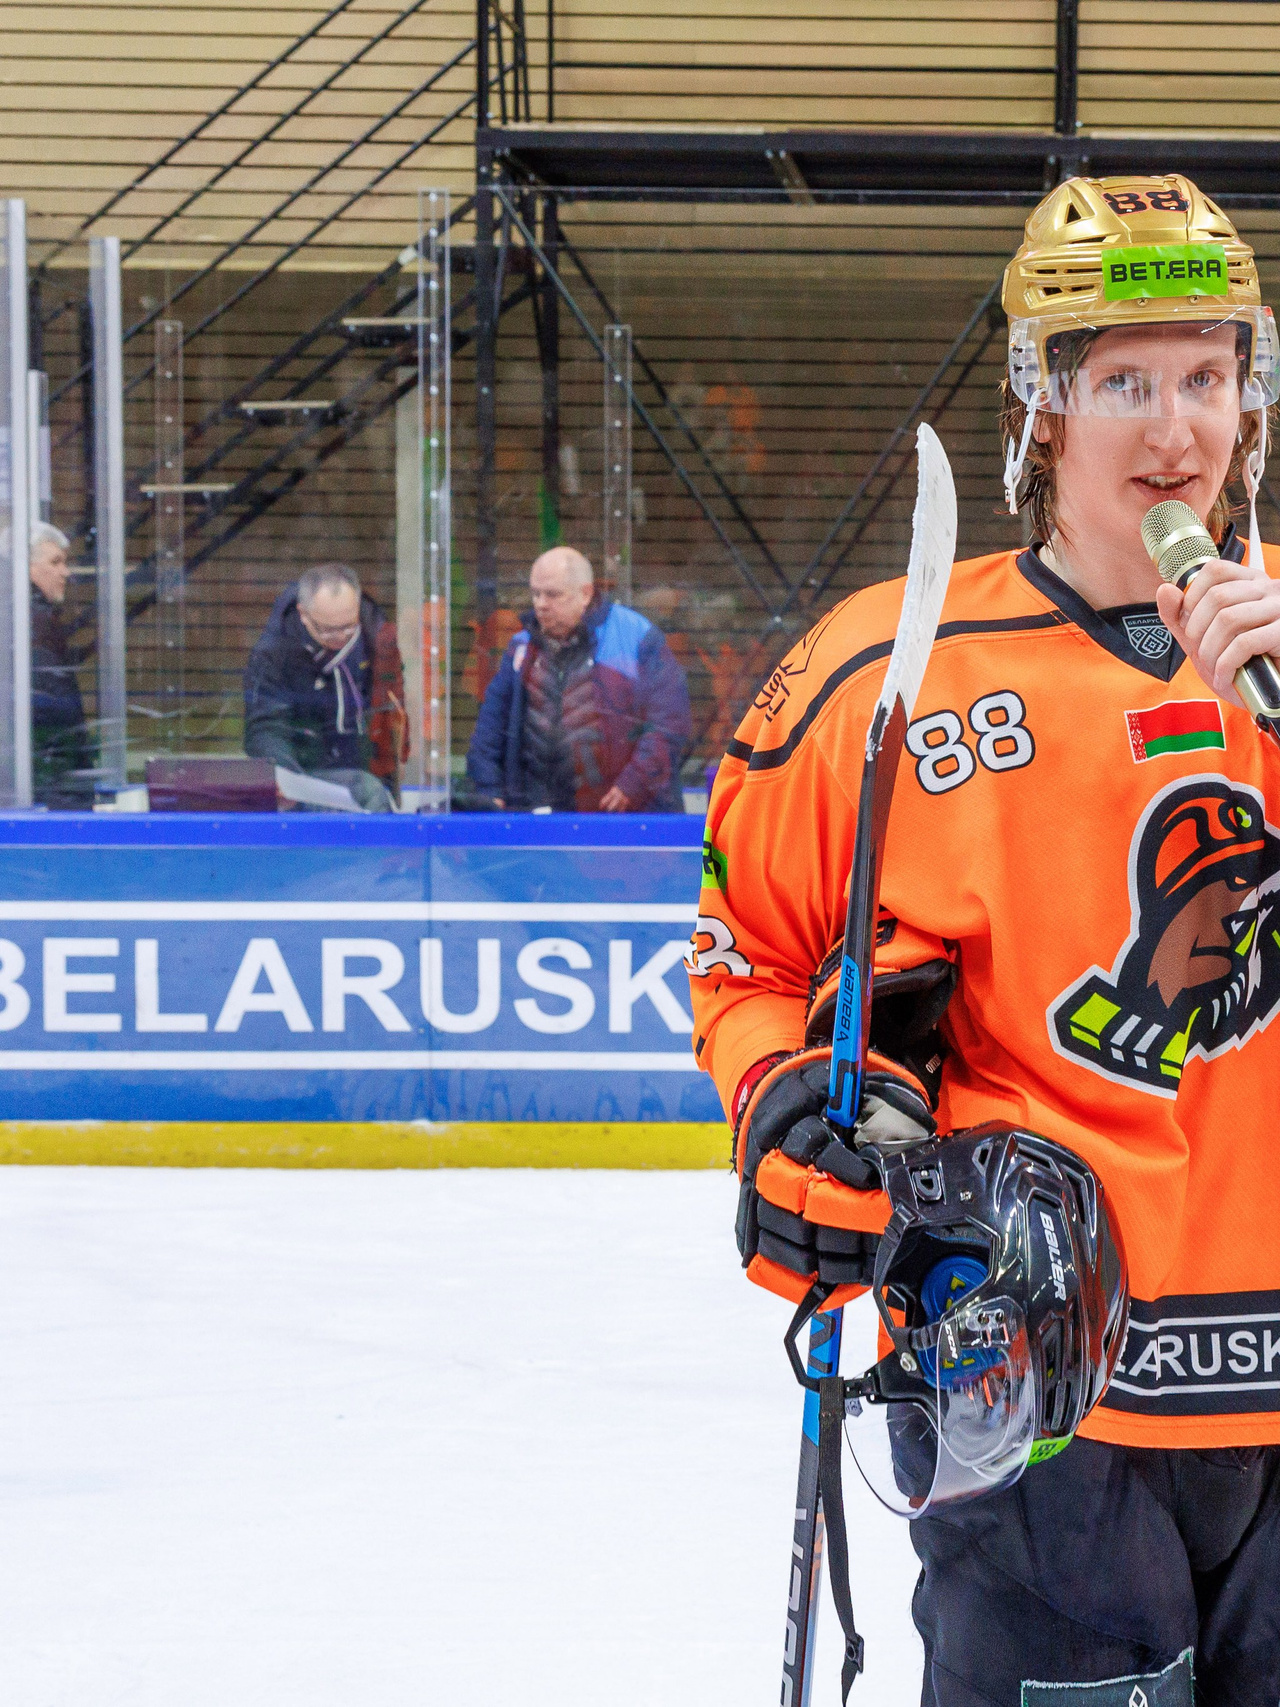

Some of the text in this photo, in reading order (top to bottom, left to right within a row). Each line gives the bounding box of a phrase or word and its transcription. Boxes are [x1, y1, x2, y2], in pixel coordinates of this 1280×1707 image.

[1102, 189, 1190, 215] 88
[1127, 618, 1164, 626] БЕЛАРУС
[905, 689, 1035, 796] 88
